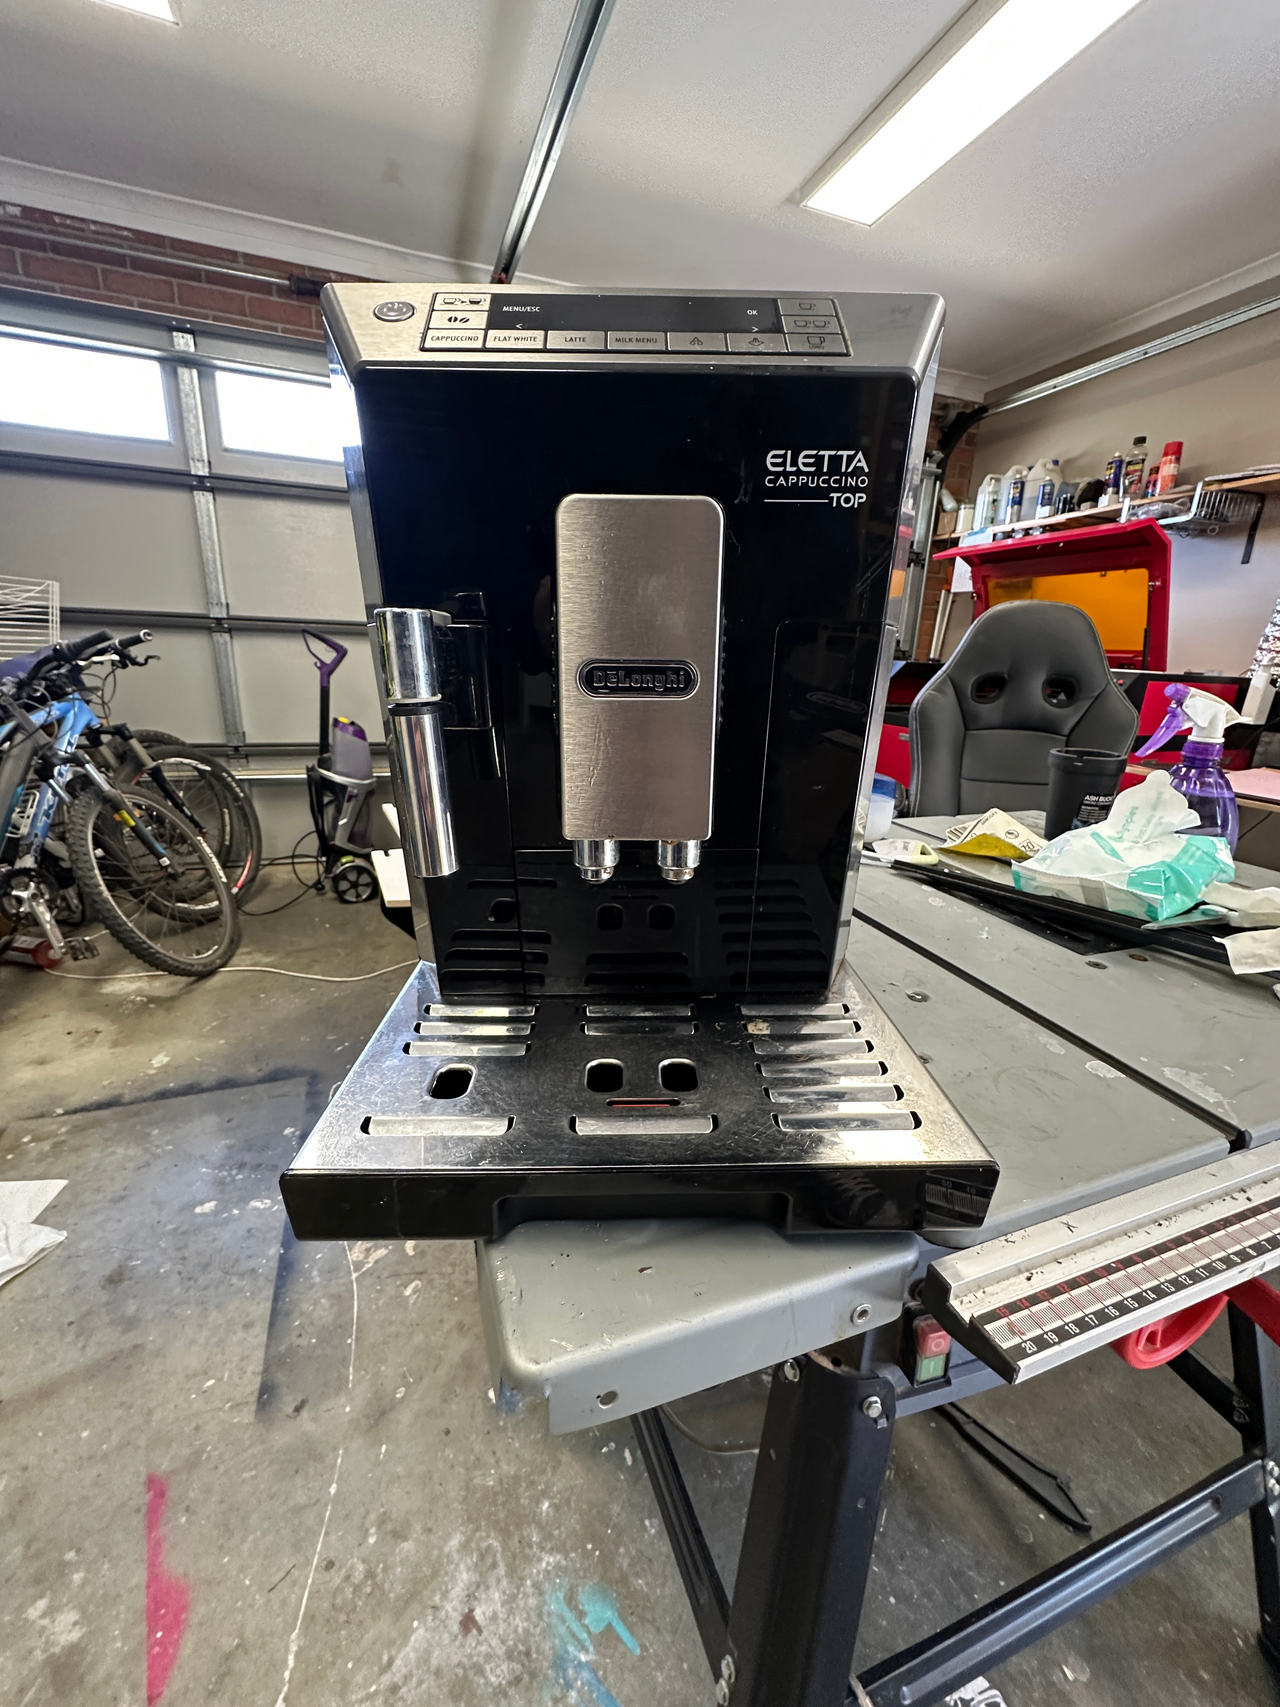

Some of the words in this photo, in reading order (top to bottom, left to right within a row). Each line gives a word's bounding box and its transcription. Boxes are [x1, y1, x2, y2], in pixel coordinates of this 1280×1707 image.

[766, 449, 869, 473] ELETTA
[765, 476, 869, 488] CAPPUCCINO
[829, 492, 867, 508] TOP
[1021, 1340, 1037, 1354] 20
[1043, 1331, 1059, 1344] 19
[1064, 1322, 1080, 1335] 18
[1084, 1313, 1099, 1326] 17
[1104, 1306, 1119, 1318] 16
[1123, 1298, 1139, 1309] 15
[1142, 1290, 1158, 1301] 14
[1161, 1282, 1175, 1293] 13
[1178, 1274, 1194, 1285] 12
[1195, 1267, 1210, 1278] 11
[1212, 1260, 1227, 1271] 10
[1229, 1253, 1242, 1263] 9
[1260, 1240, 1272, 1250] 7
